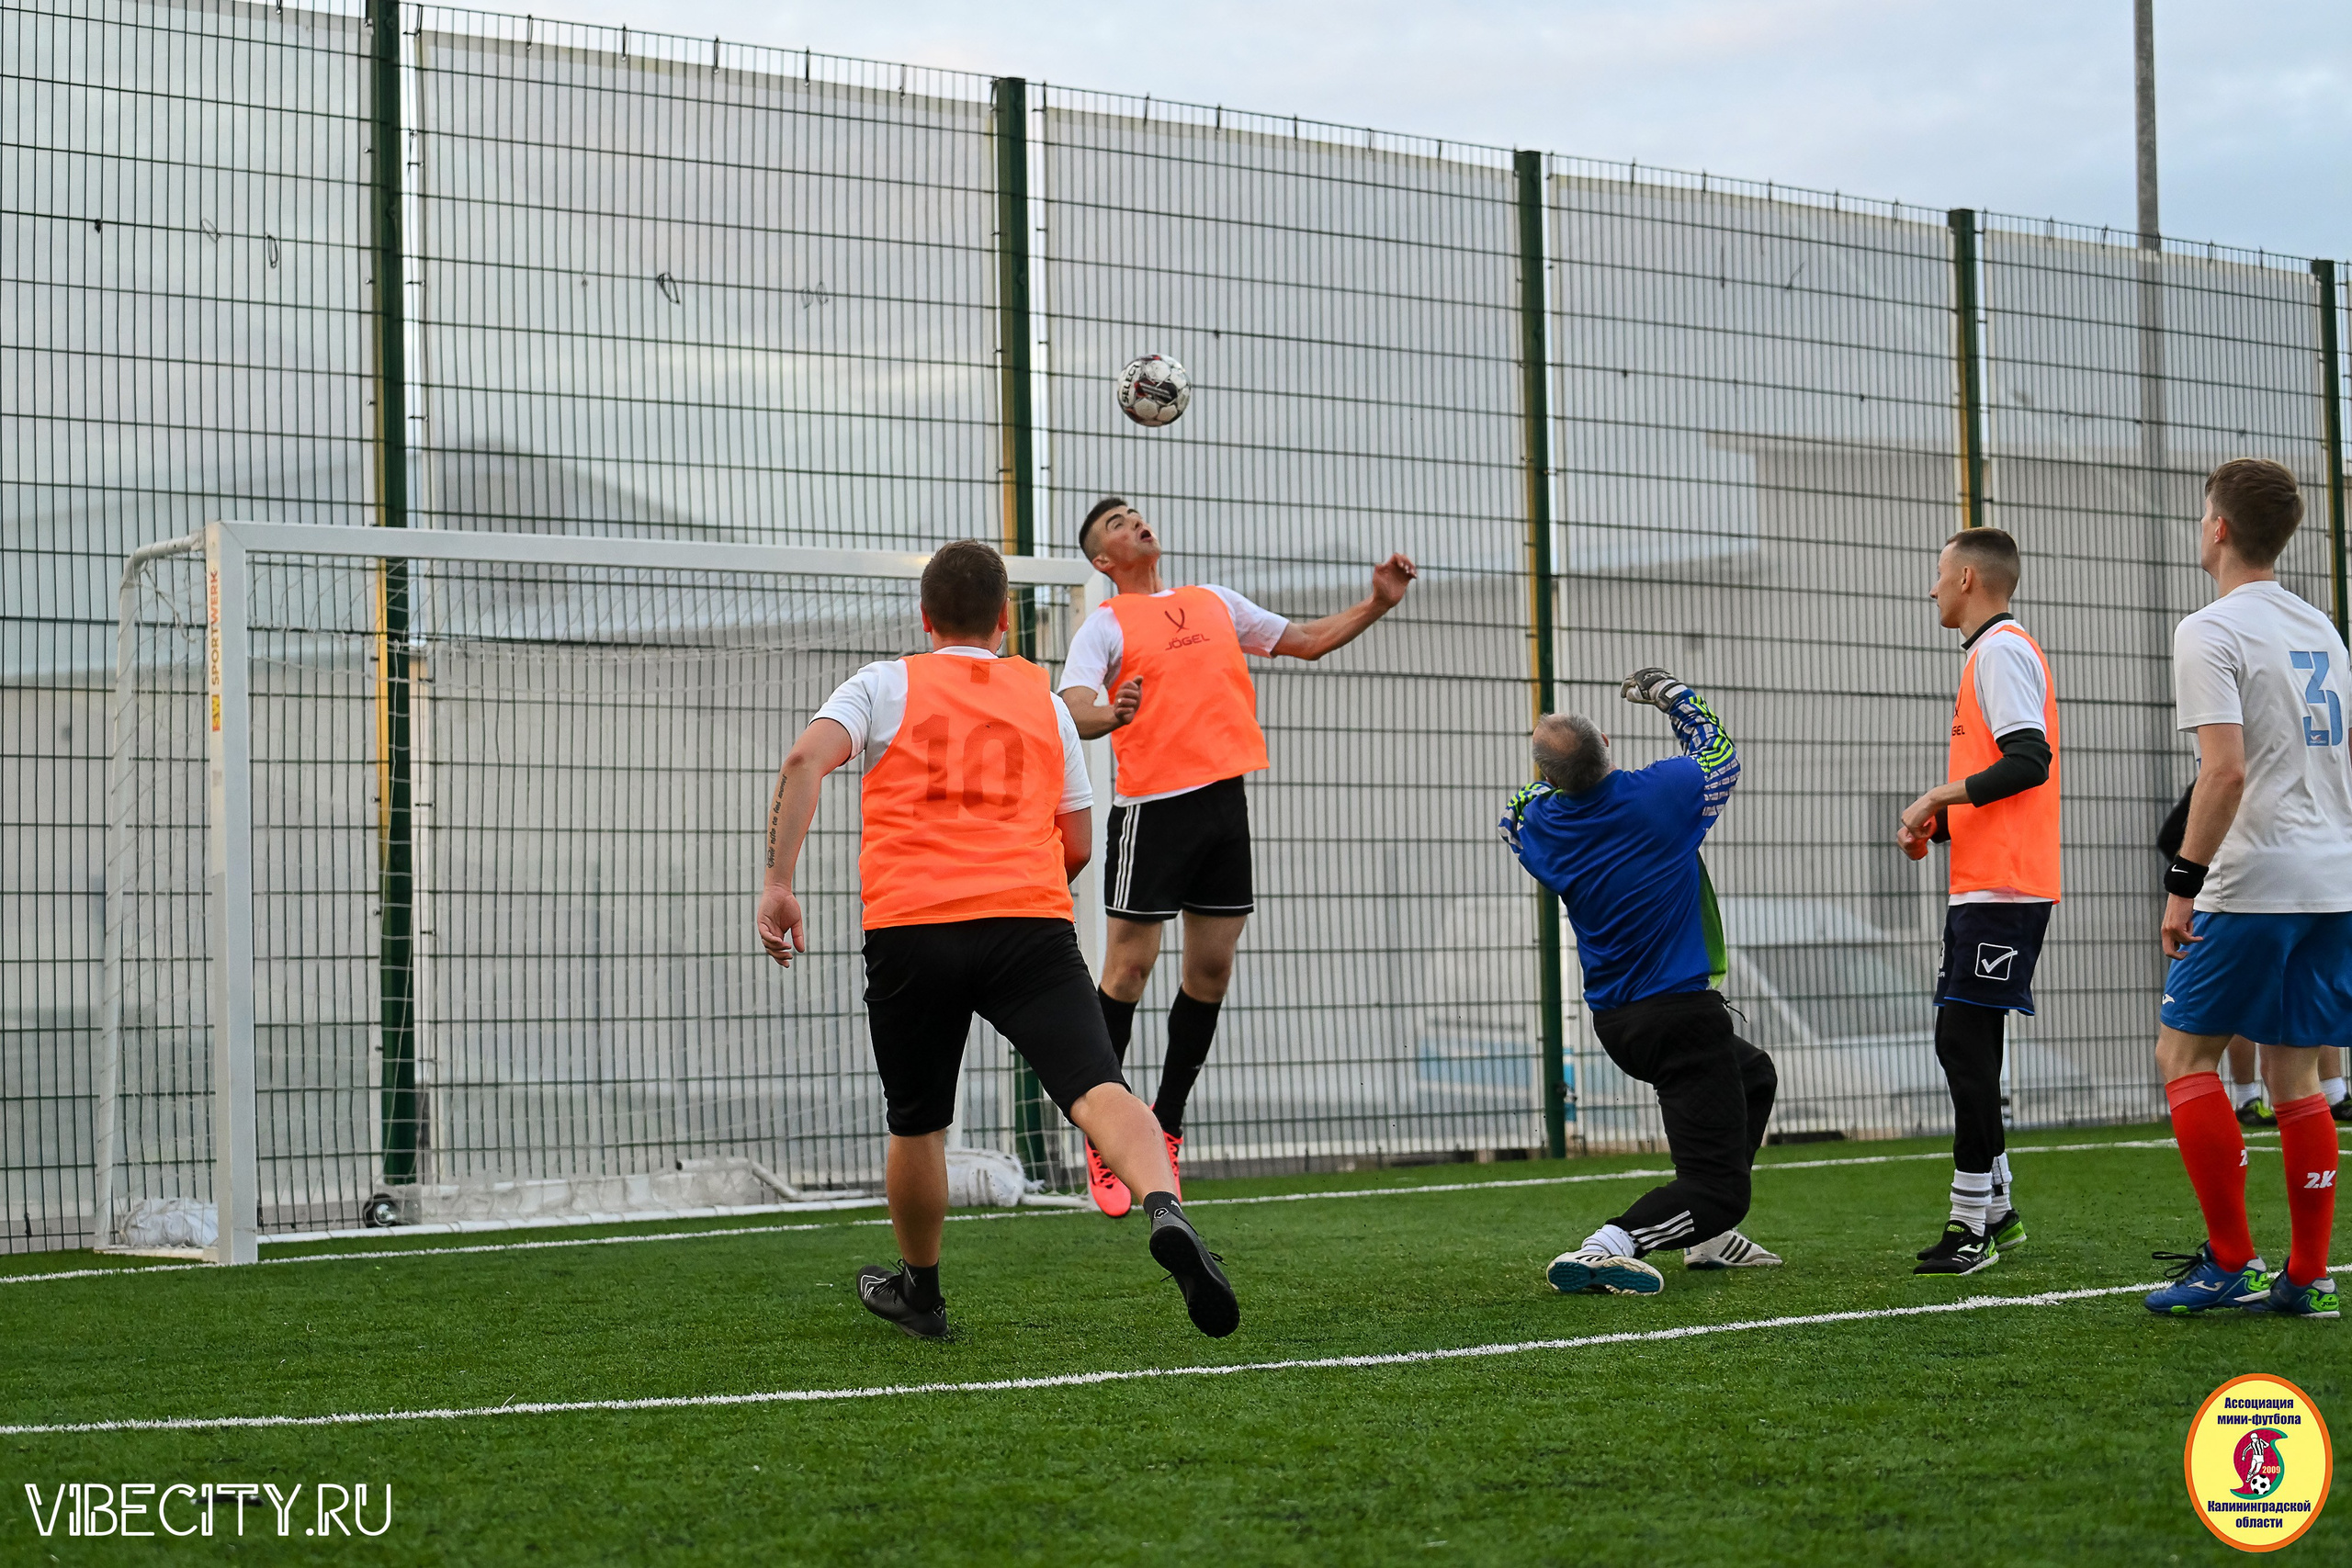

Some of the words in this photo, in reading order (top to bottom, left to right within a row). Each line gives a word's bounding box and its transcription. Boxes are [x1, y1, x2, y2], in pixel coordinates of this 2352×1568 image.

[1121, 364, 1139, 403] SELECT
[210, 570, 220, 686] SPORTWERK
[1164, 634, 1210, 651] JÖGEL
[2289, 651, 2344, 746] 3
[1951, 725, 1965, 737] GEL
[910, 714, 1024, 821] 10
[2303, 1170, 2336, 1189] 2K
